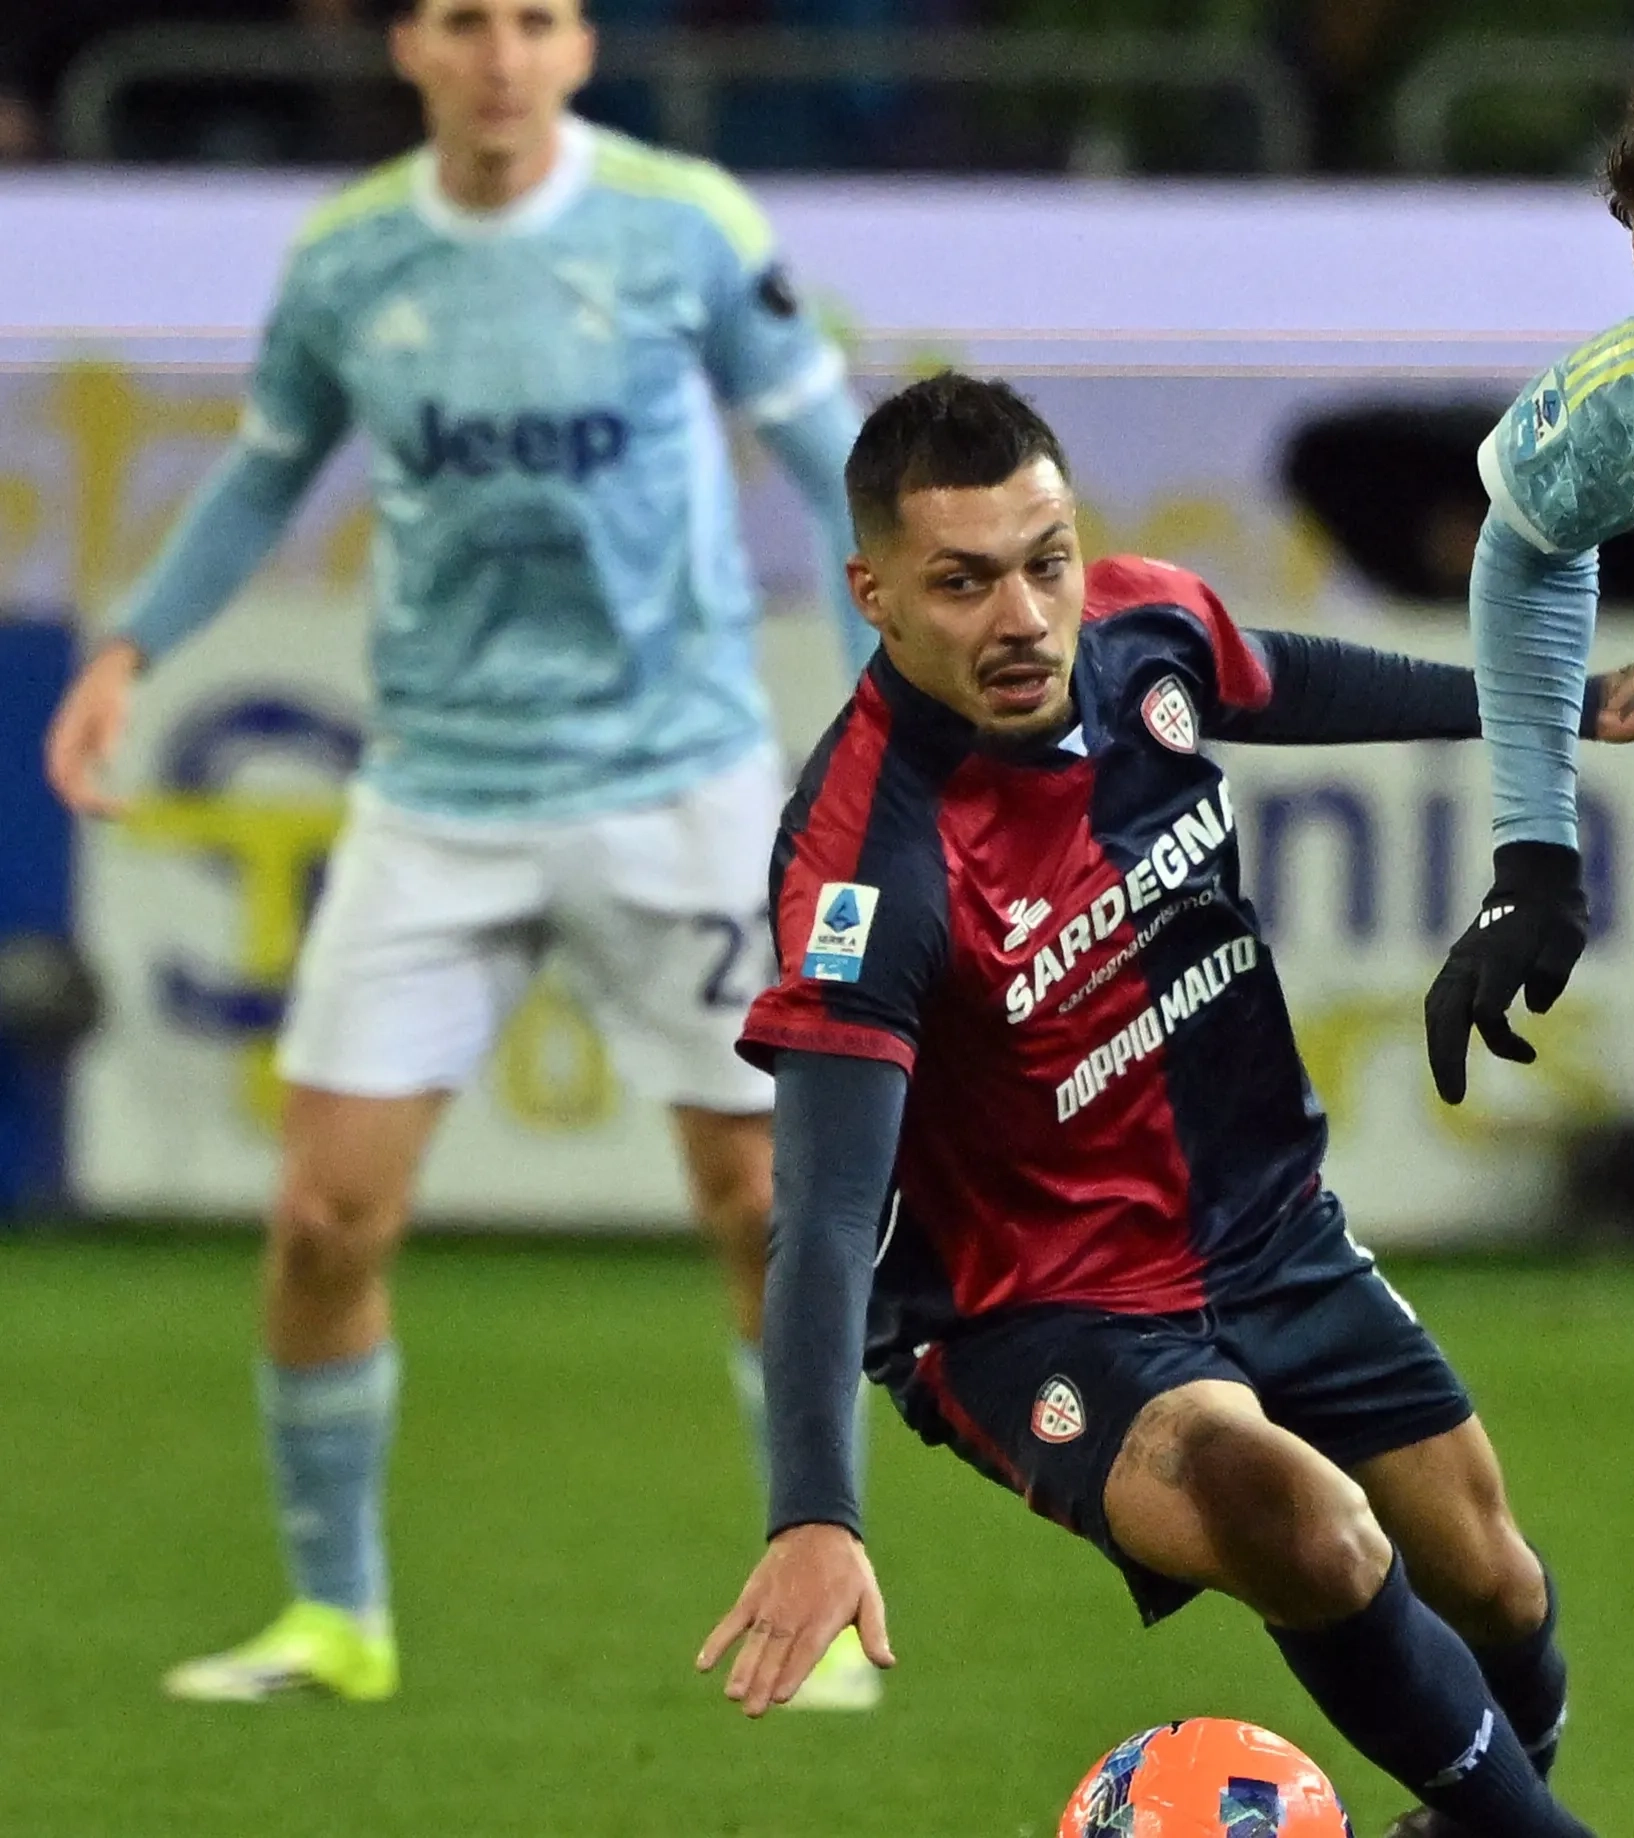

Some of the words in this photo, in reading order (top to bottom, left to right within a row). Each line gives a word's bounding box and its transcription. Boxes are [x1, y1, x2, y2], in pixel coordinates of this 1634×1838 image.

[392, 398, 633, 485] Jeep
[1056, 1006, 1164, 1124] DOPPIO
[1160, 935, 1257, 1035] MALTO
